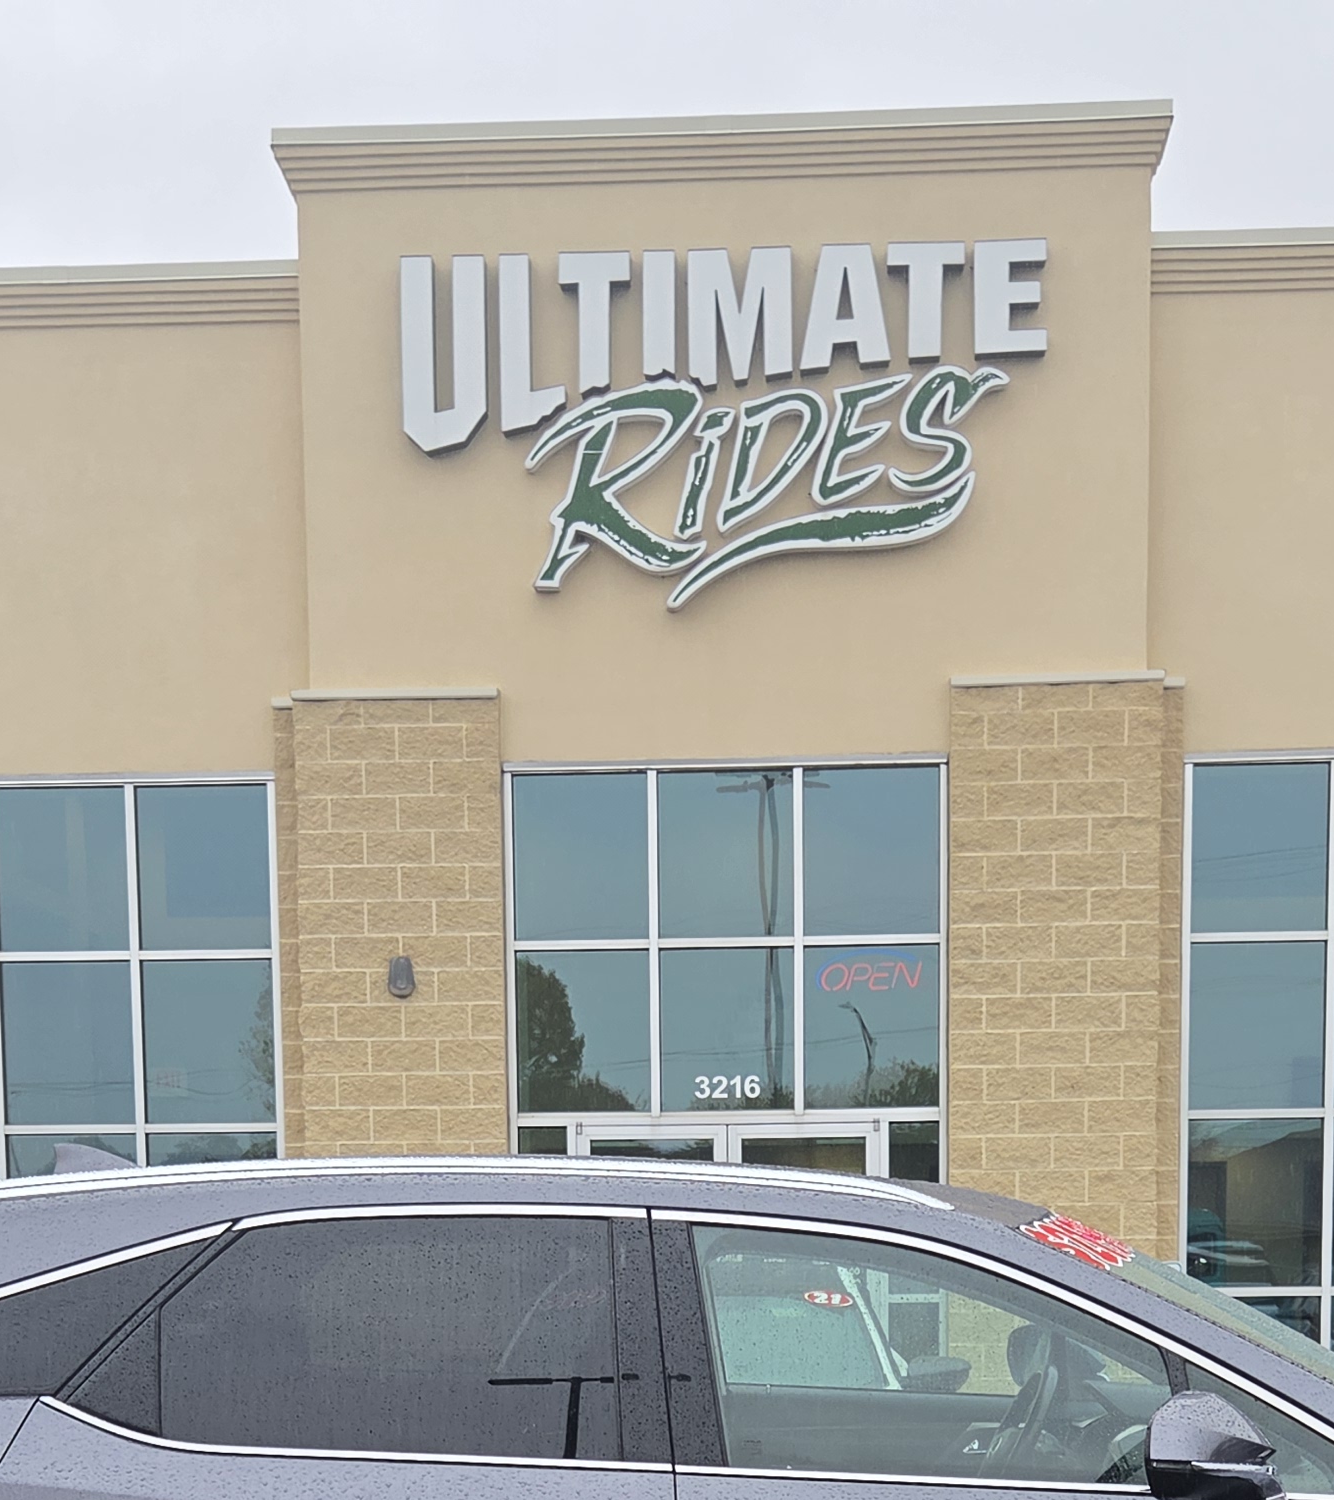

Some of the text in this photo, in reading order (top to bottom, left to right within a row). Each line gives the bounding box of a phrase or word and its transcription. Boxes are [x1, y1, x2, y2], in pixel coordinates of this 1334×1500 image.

[399, 237, 1048, 456] ULTIMATE
[820, 960, 923, 992] OPEN
[694, 1074, 761, 1099] 3216
[813, 1291, 843, 1305] 21
